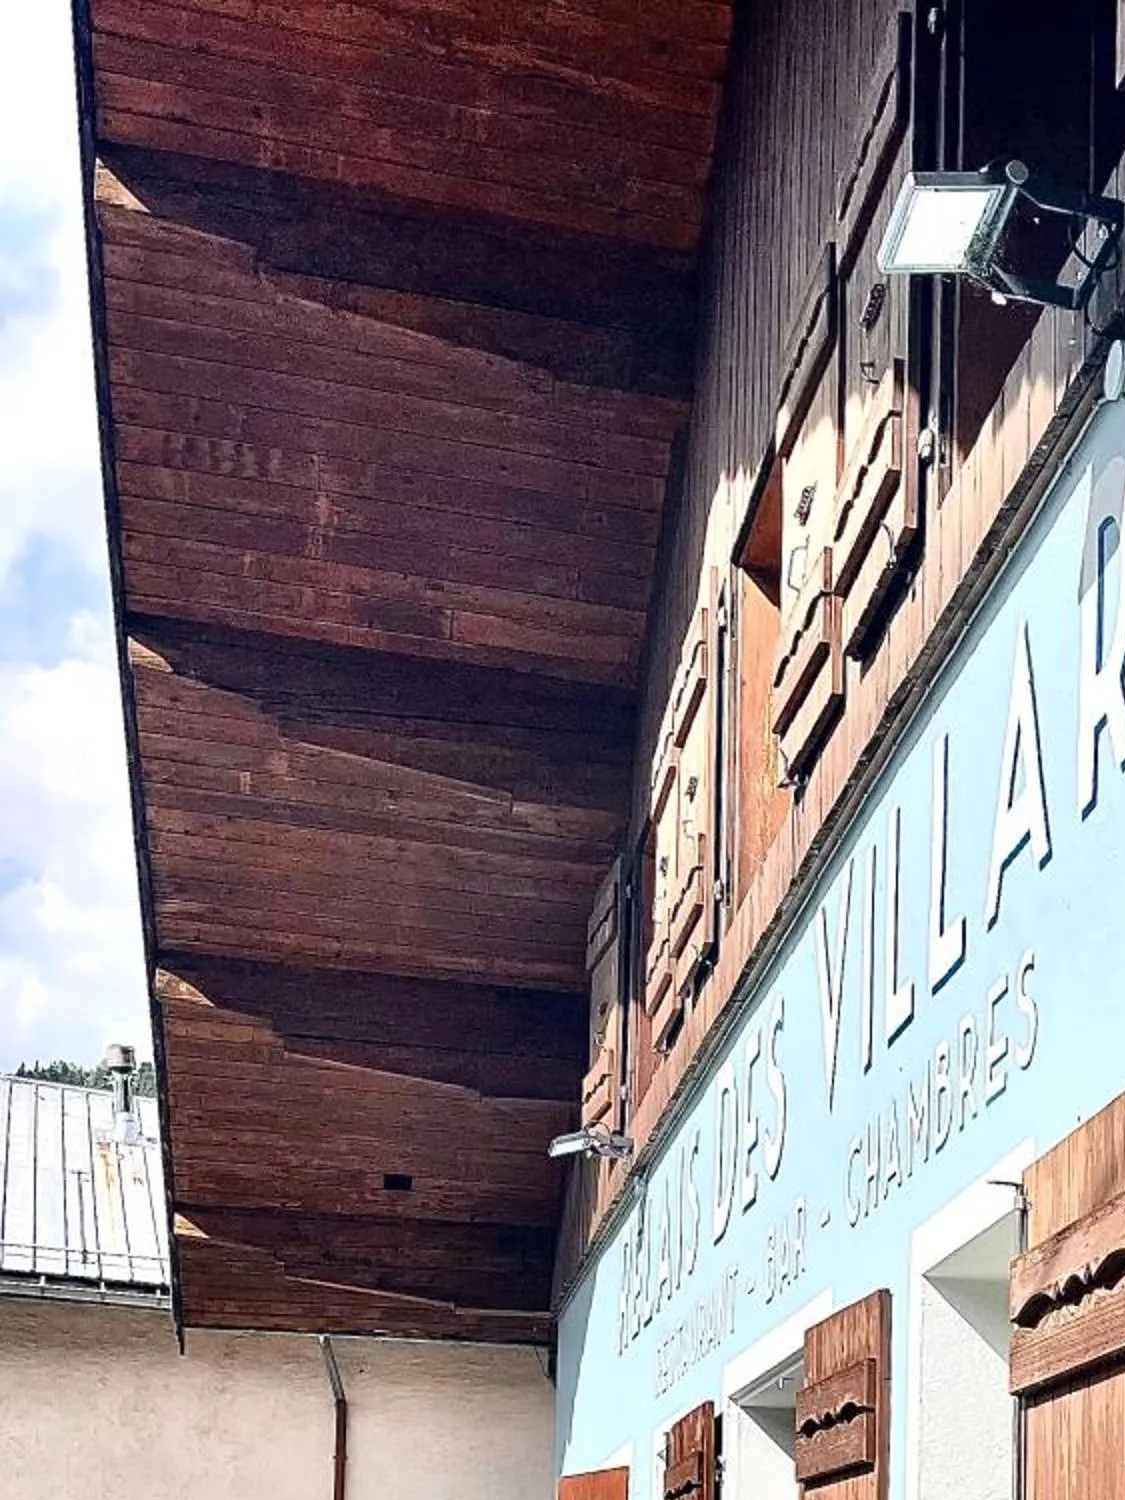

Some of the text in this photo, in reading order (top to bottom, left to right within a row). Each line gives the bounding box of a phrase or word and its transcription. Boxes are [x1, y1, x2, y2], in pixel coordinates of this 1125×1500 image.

[617, 1129, 700, 1357] RELAIS
[711, 997, 787, 1247] DES
[765, 1194, 807, 1305] BAR
[846, 947, 1039, 1229] CHAMBRES
